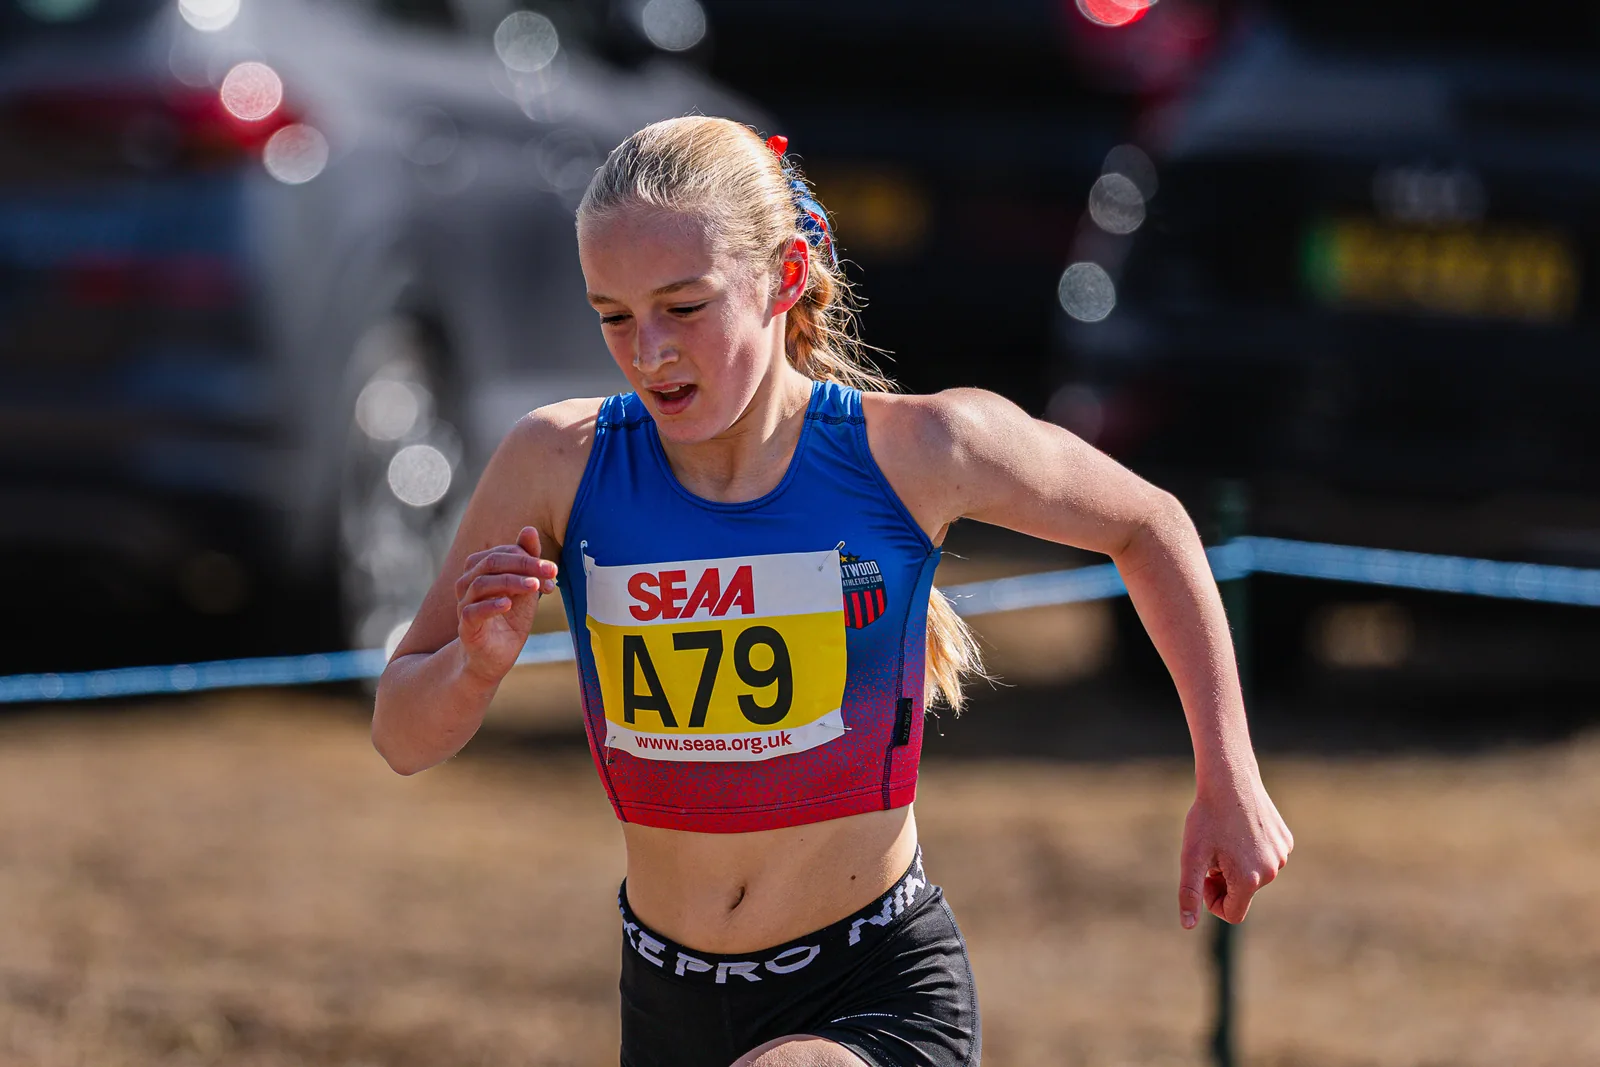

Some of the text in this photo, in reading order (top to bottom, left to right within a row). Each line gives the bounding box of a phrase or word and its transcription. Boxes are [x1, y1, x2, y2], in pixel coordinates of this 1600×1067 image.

[627, 565, 755, 622] SEAA
[842, 574, 883, 586] ATHLETICS CLUB
[622, 625, 794, 728] A79
[635, 731, 793, 754] www.seaa.org.uk
[674, 944, 821, 984] PRO
